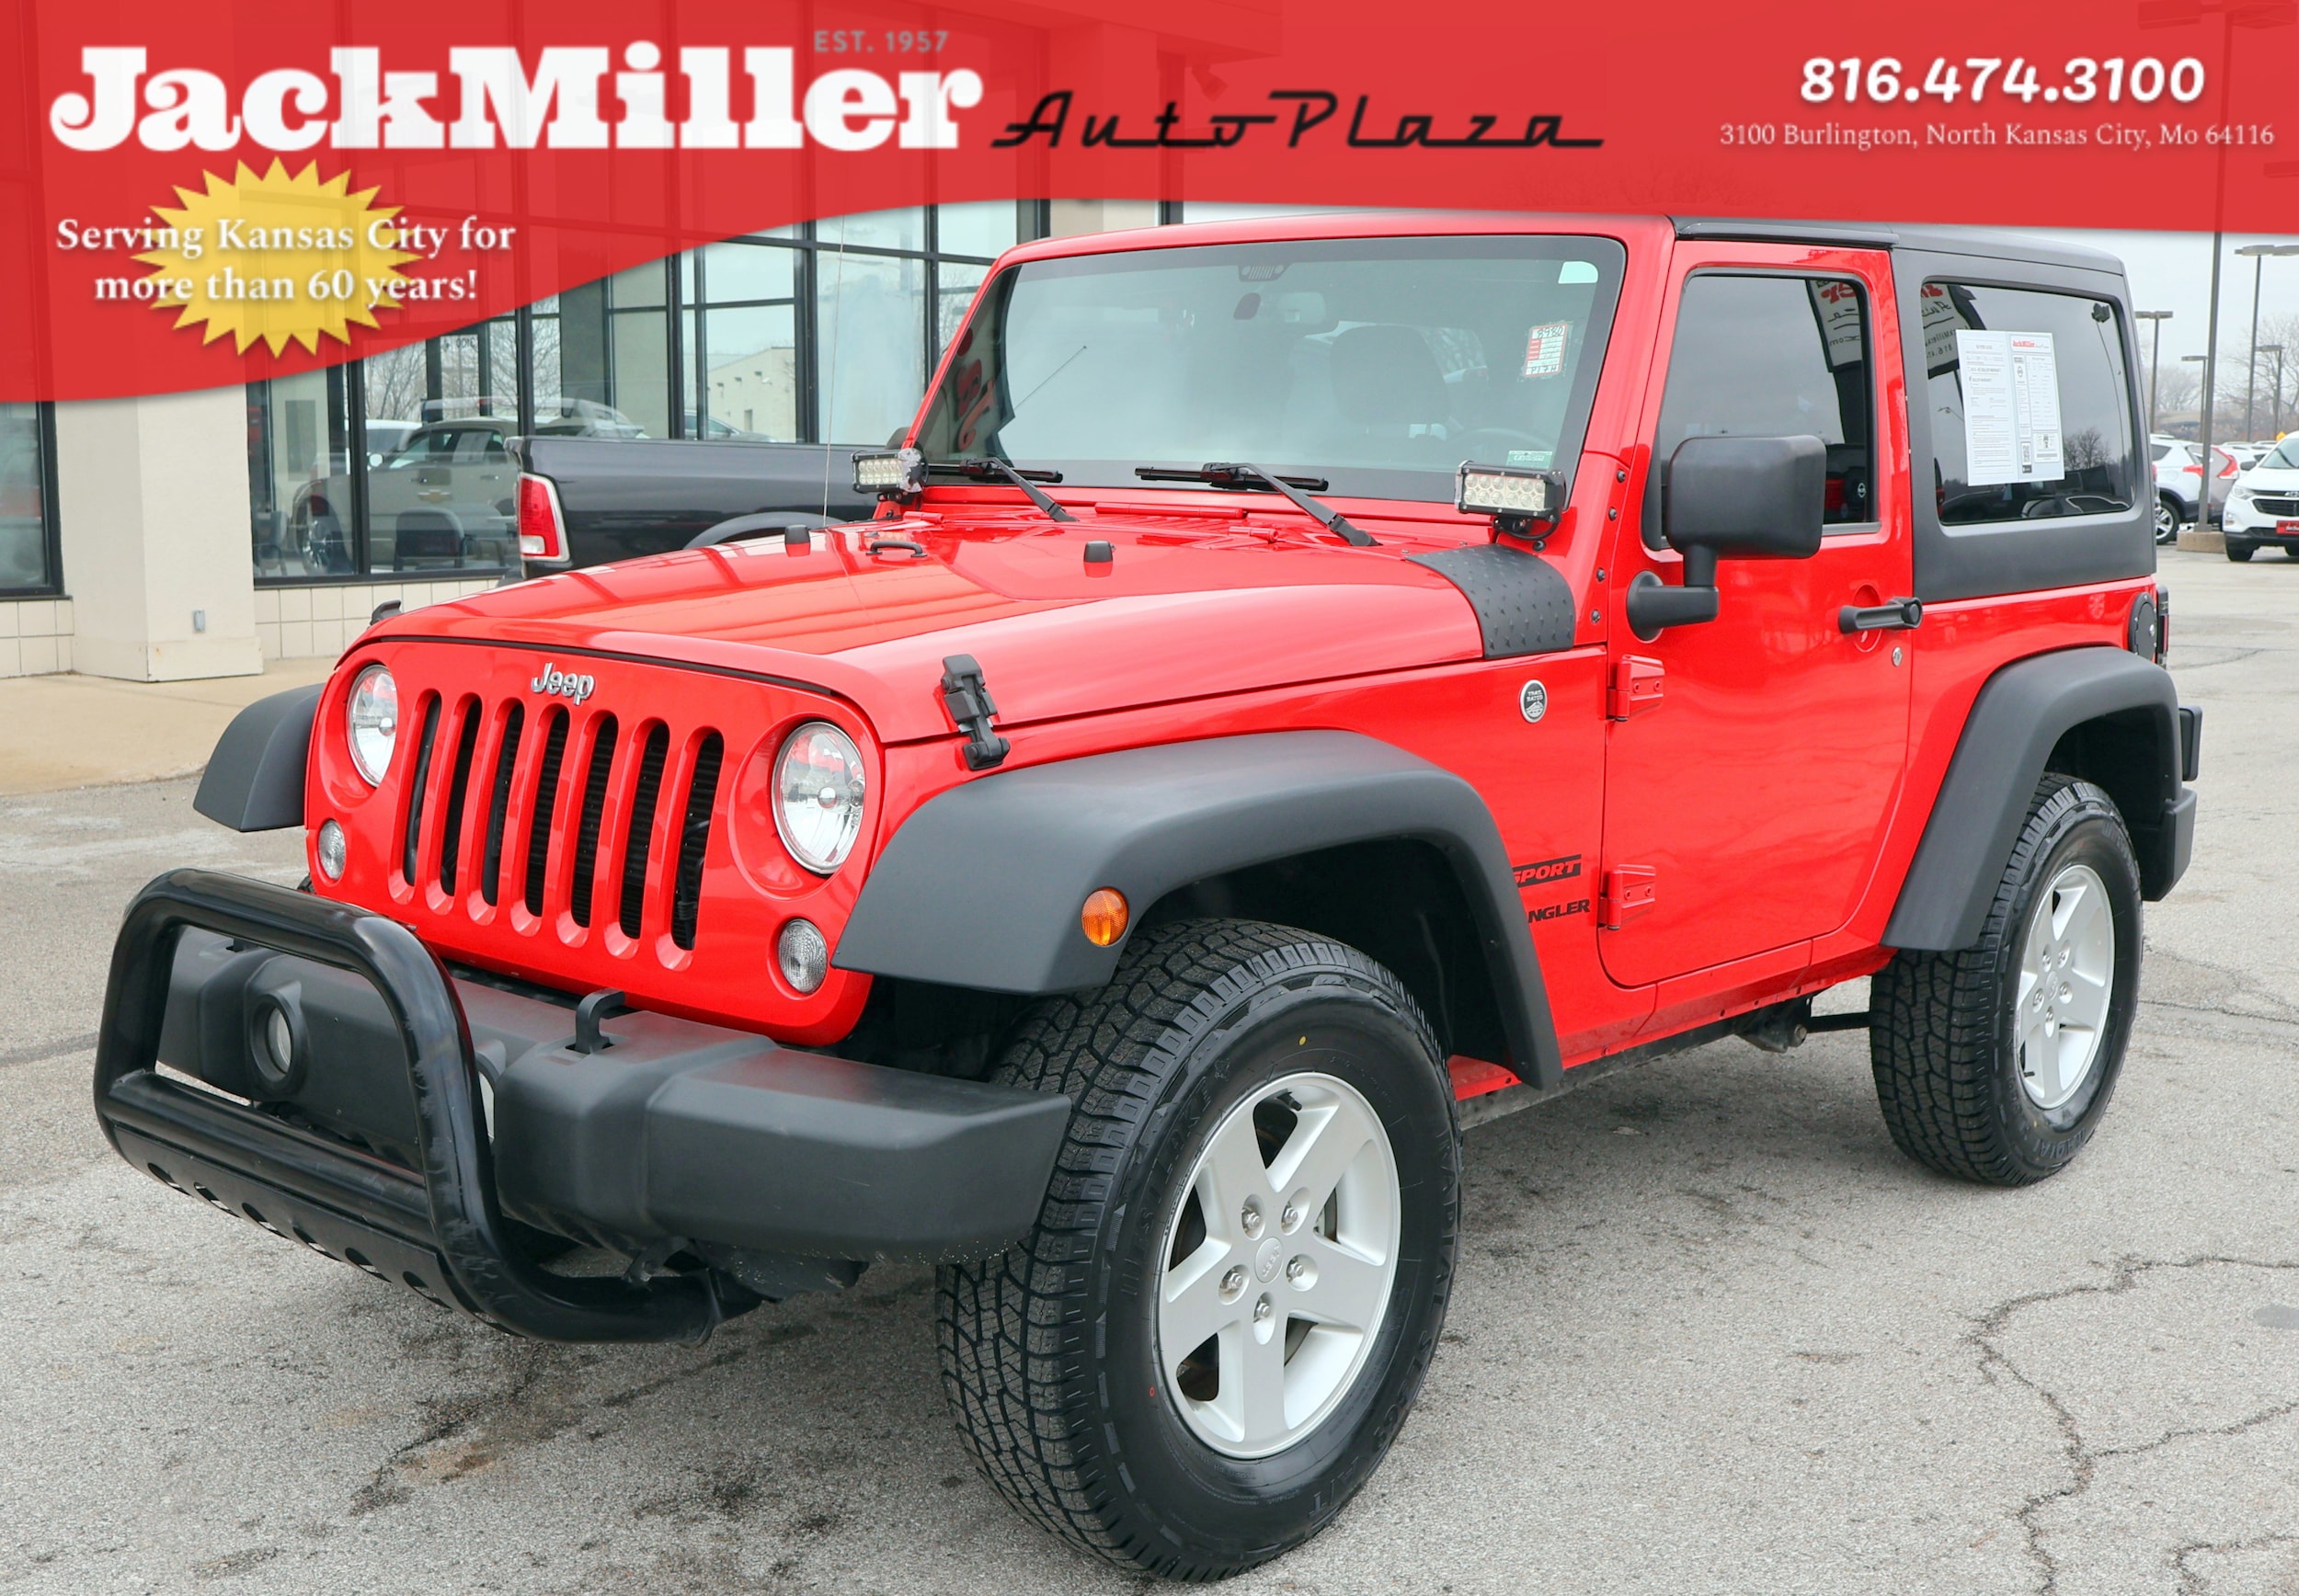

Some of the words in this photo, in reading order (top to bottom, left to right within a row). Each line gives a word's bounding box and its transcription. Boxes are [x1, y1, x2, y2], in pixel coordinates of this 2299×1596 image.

[531, 662, 595, 706] Jeep
[1513, 860, 1581, 884] SPORT
[1527, 899, 1591, 923] NGLER
